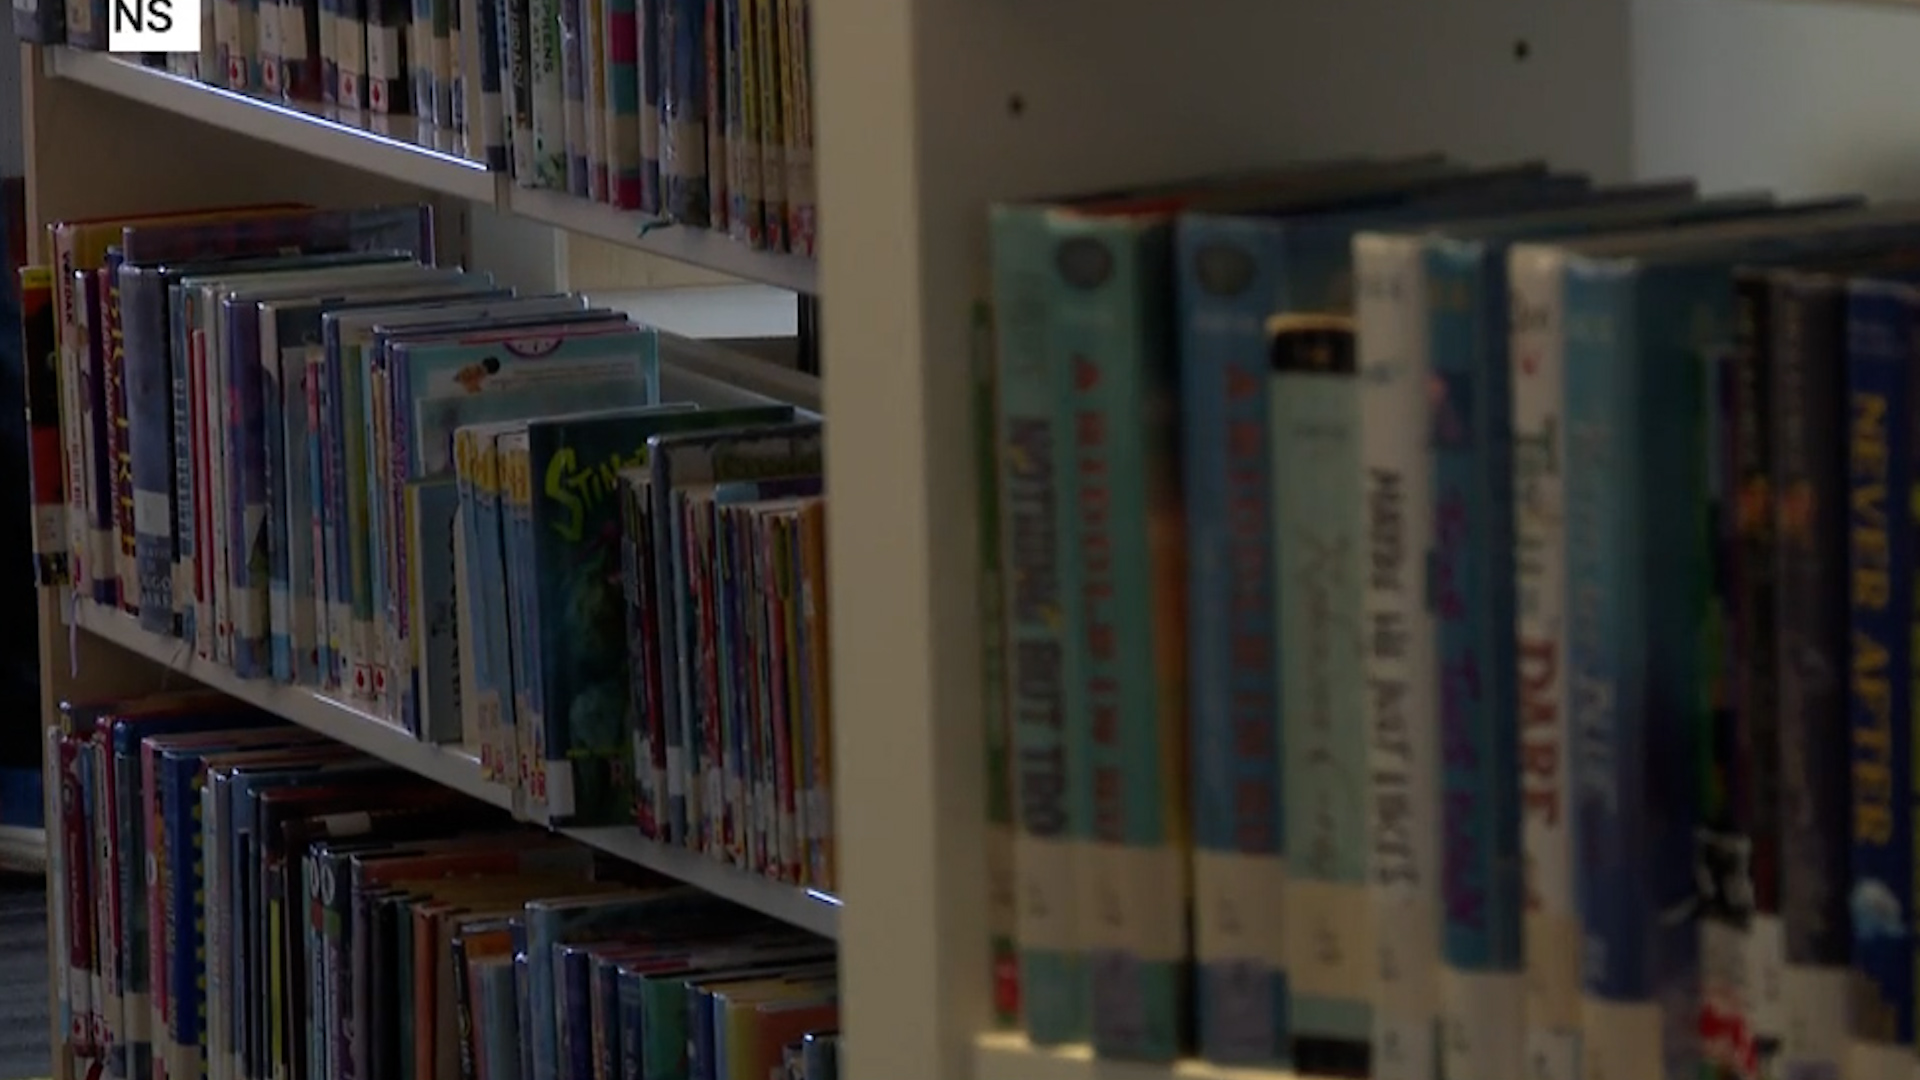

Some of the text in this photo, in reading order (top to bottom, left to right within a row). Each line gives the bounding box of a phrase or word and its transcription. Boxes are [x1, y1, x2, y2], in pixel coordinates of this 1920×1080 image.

[1072, 354, 1101, 394] A
[1849, 390, 1892, 612] NEVER
[1018, 638, 1065, 728] BUT
[1850, 633, 1895, 847] AFTER
